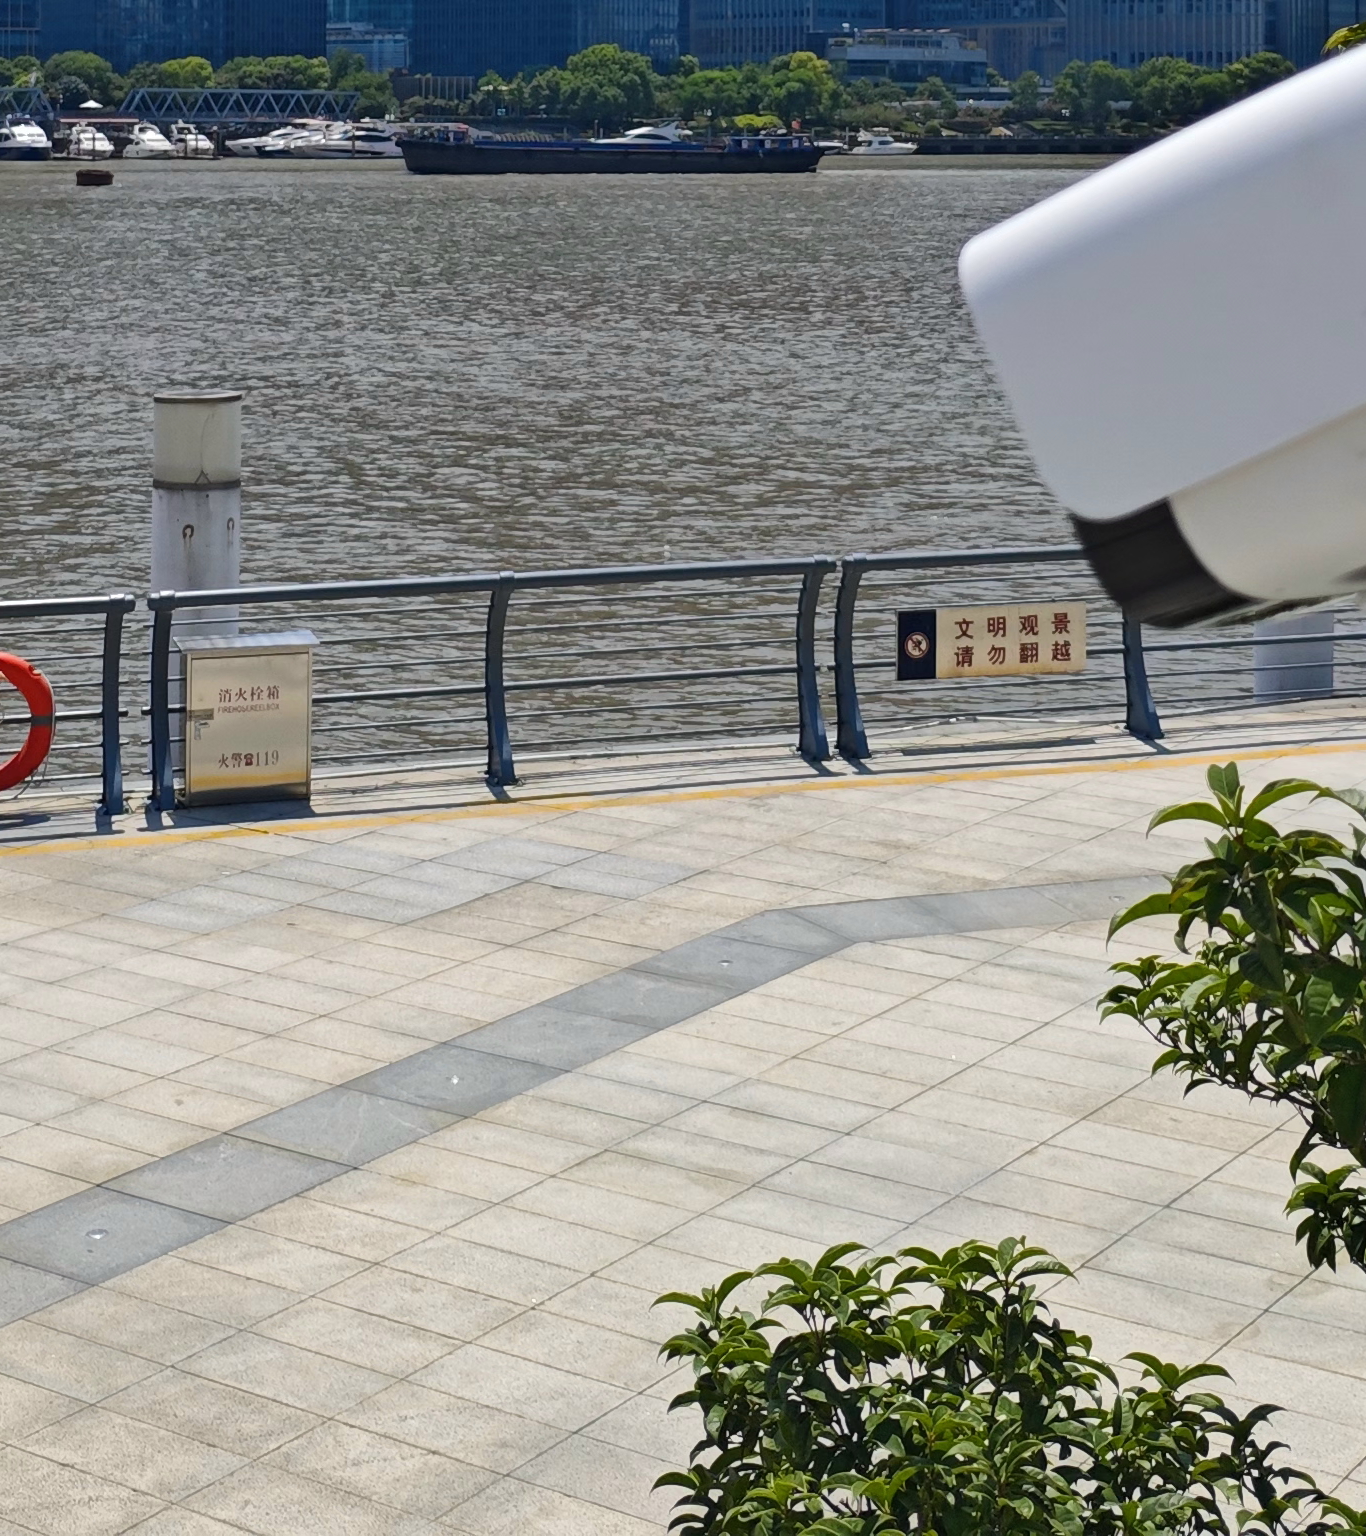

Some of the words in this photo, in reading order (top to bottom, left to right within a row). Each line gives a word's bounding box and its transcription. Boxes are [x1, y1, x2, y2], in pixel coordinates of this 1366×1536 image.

[954, 612, 1071, 639] 文明观景
[954, 640, 1071, 667] 请勿翻越
[218, 685, 280, 703] 消火栓箱
[218, 752, 242, 768] 火警
[255, 750, 279, 767] 119
